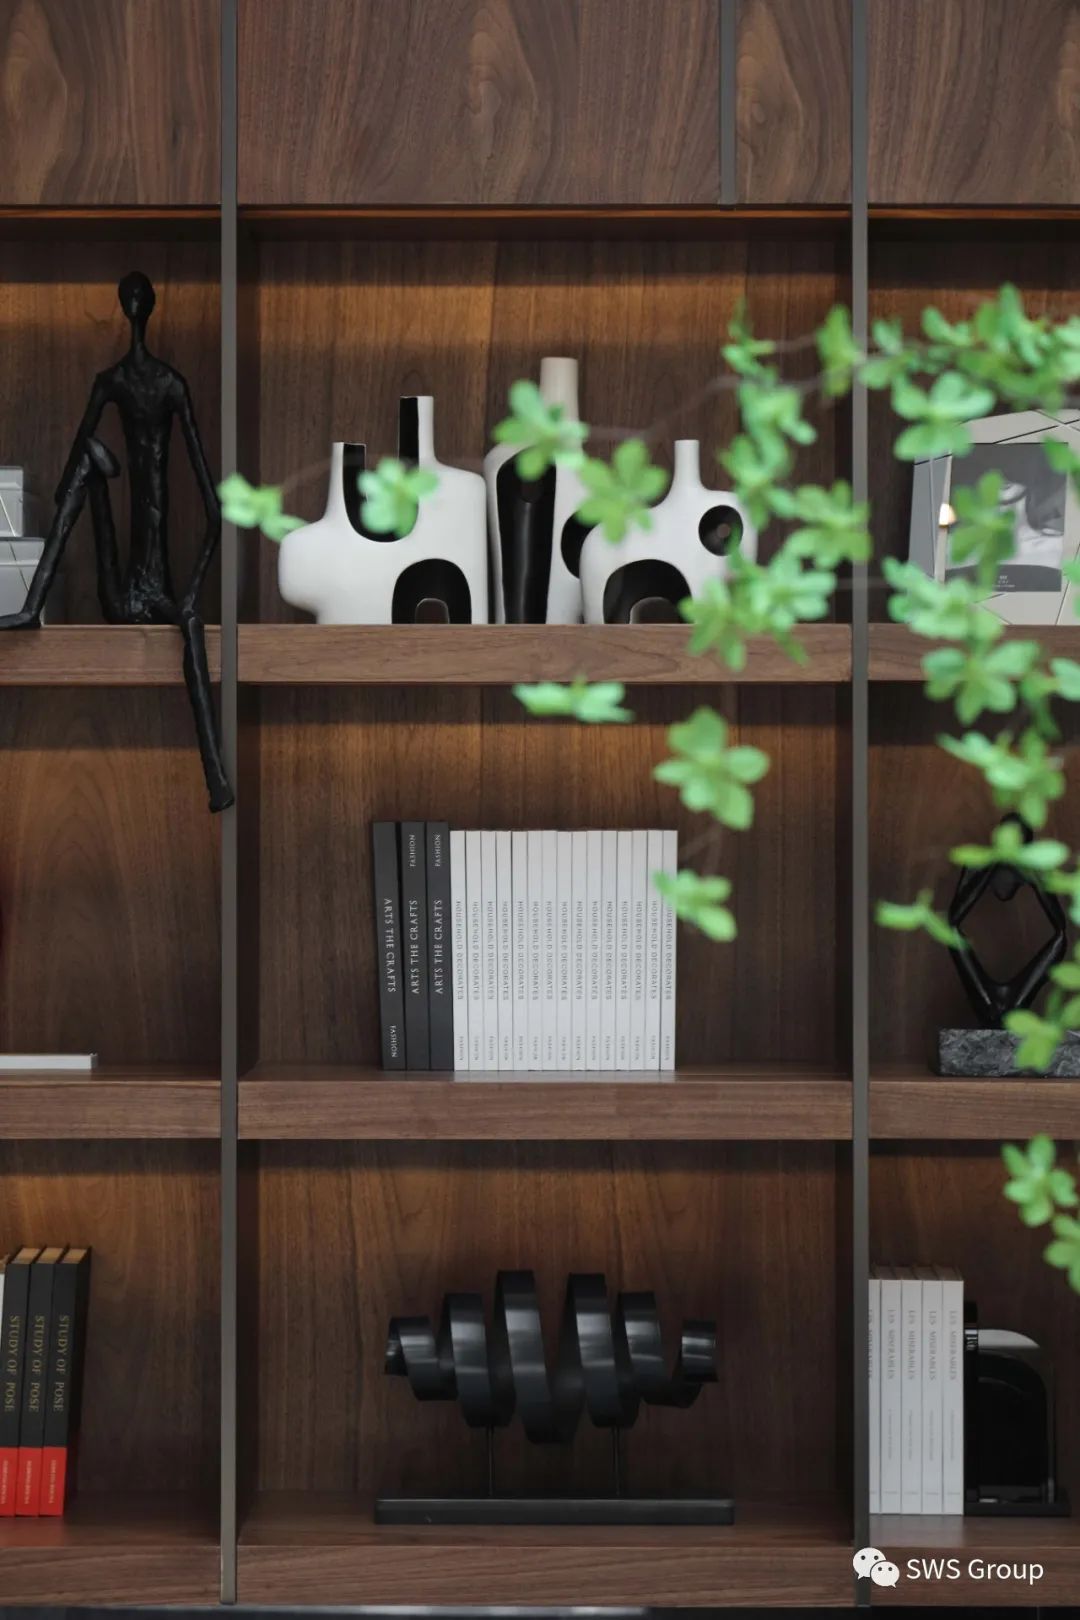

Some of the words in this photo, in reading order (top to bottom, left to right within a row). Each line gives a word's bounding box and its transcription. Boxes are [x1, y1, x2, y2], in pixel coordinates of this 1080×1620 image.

[383, 898, 394, 924] ARTS
[408, 899, 419, 940] CRAFTS
[433, 899, 443, 940] CRAFTS
[385, 929, 395, 948] THE
[409, 943, 419, 963] THE
[434, 943, 443, 963] THE
[385, 952, 397, 993] CRAFTS
[409, 967, 420, 994] ARTS
[434, 967, 444, 994] ARTS
[389, 1025, 398, 1058] FASHION
[8, 1315, 20, 1356] STUDY
[32, 1315, 45, 1356] STUDY
[56, 1315, 70, 1356] STUDY
[7, 1359, 18, 1376] OF
[31, 1359, 42, 1376] OF
[55, 1358, 66, 1375] OF
[4, 1382, 16, 1412] POSE
[28, 1382, 41, 1412] POSE
[53, 1382, 65, 1412] POSE
